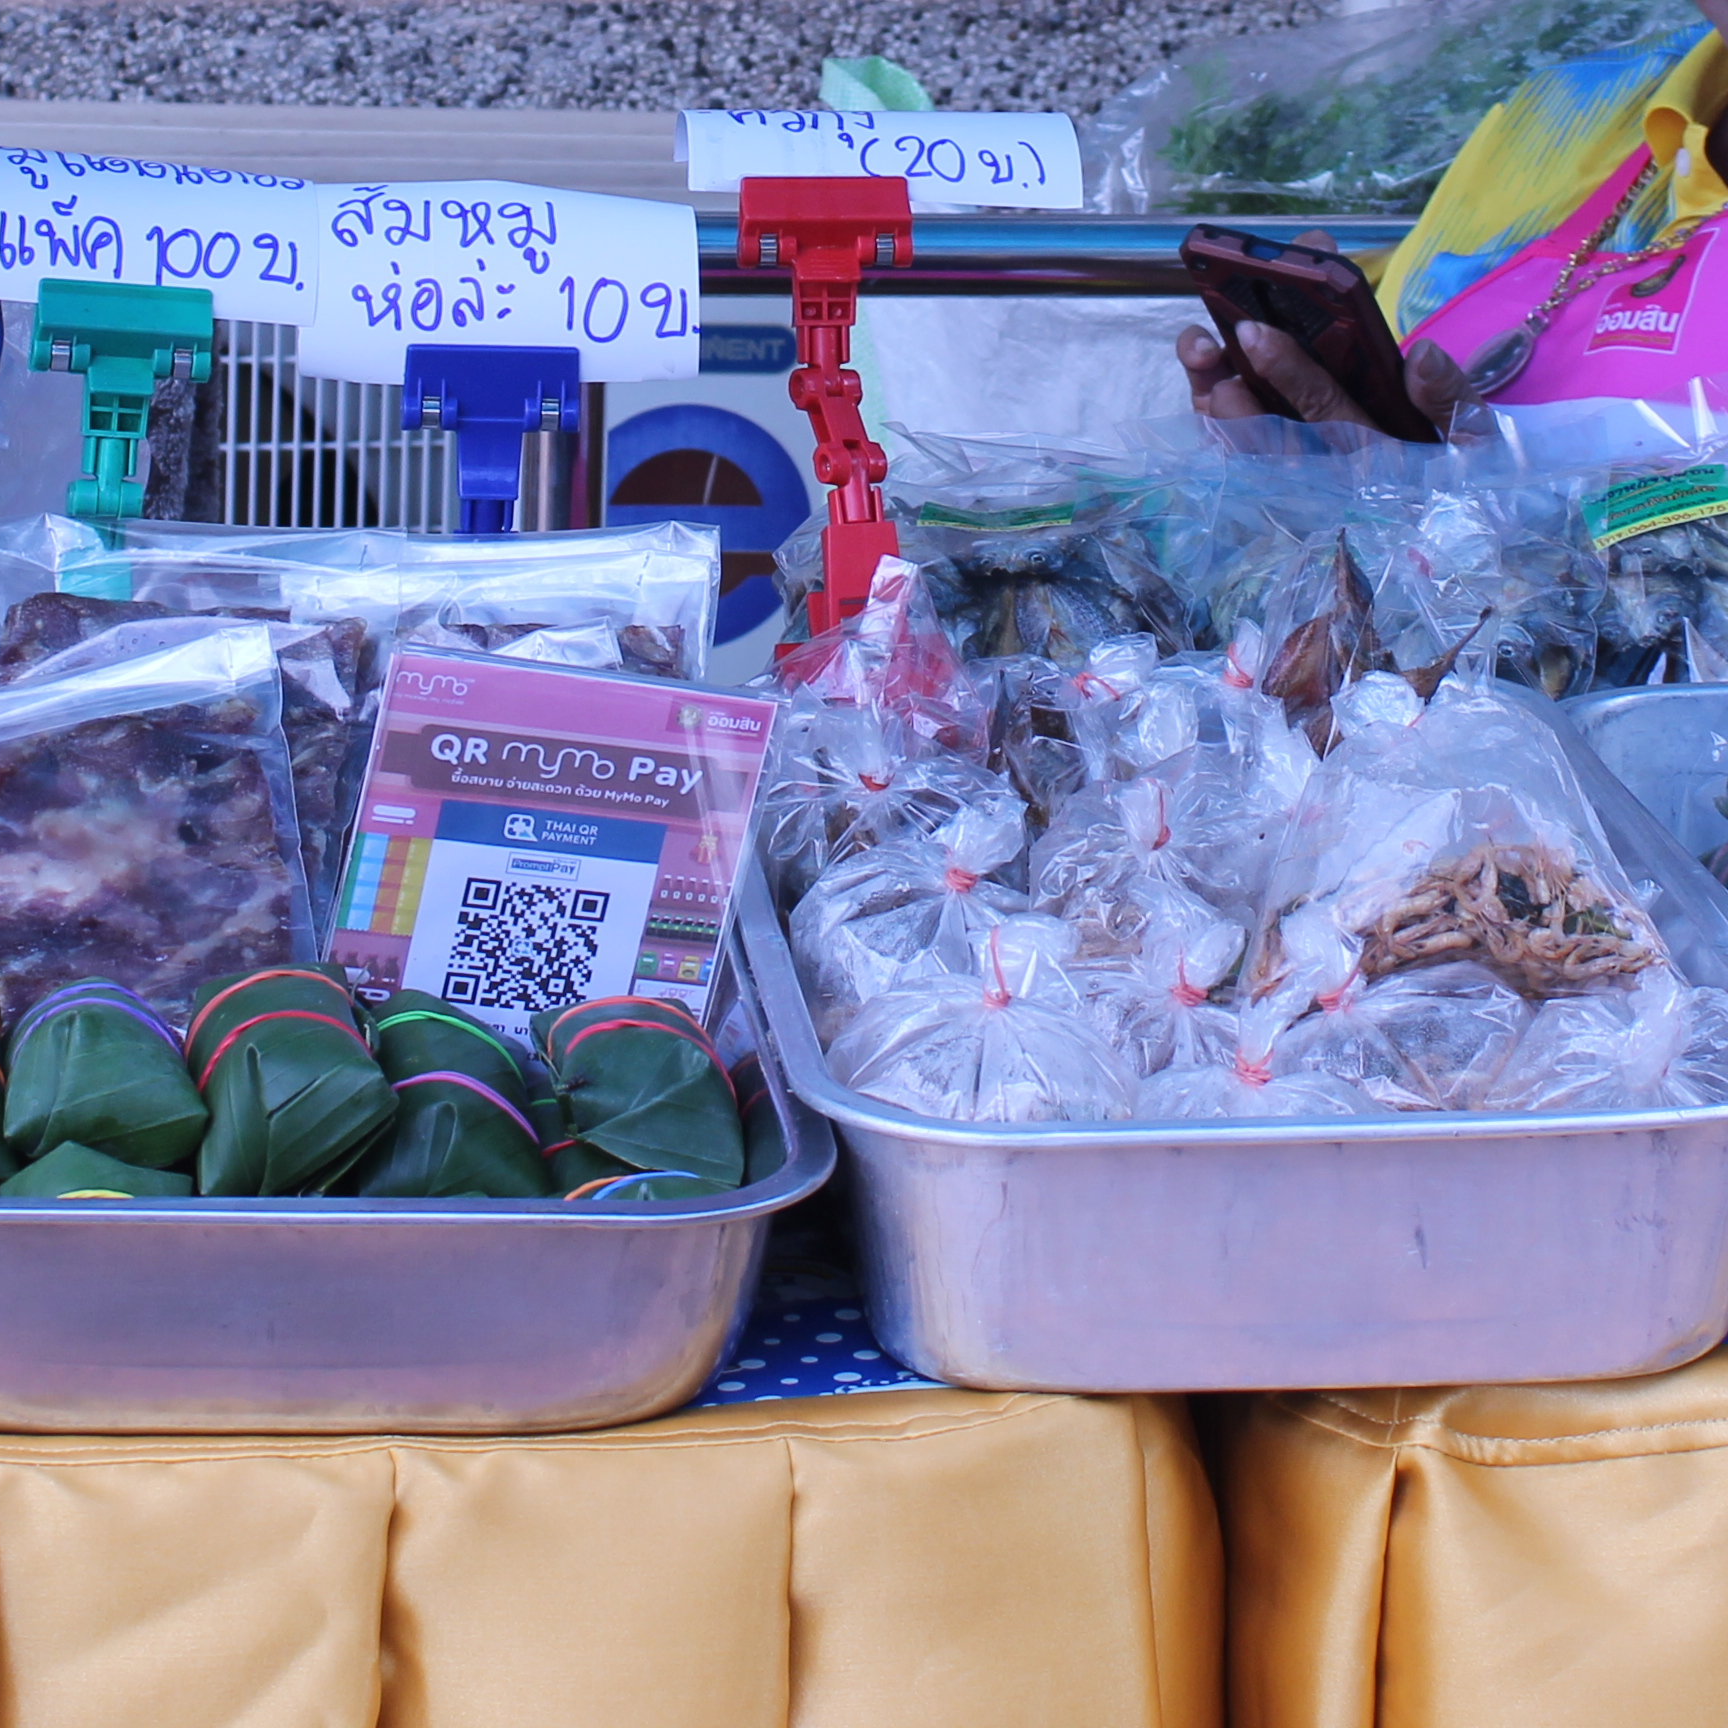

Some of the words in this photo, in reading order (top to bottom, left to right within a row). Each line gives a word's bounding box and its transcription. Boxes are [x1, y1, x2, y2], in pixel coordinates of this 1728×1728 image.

[330, 181, 559, 275] ส้มหมู
[144, 224, 242, 286] 100
[559, 274, 631, 344] 10
[706, 713, 763, 733] ออมสิน
[430, 732, 490, 766] QR
[627, 755, 704, 796] Pay
[574, 782, 602, 800] ด้วย
[603, 789, 643, 805] MyMo
[644, 794, 671, 809] Pay
[540, 830, 599, 847] PAYMENT
[544, 819, 577, 833] THAI
[578, 822, 600, 837] QR
